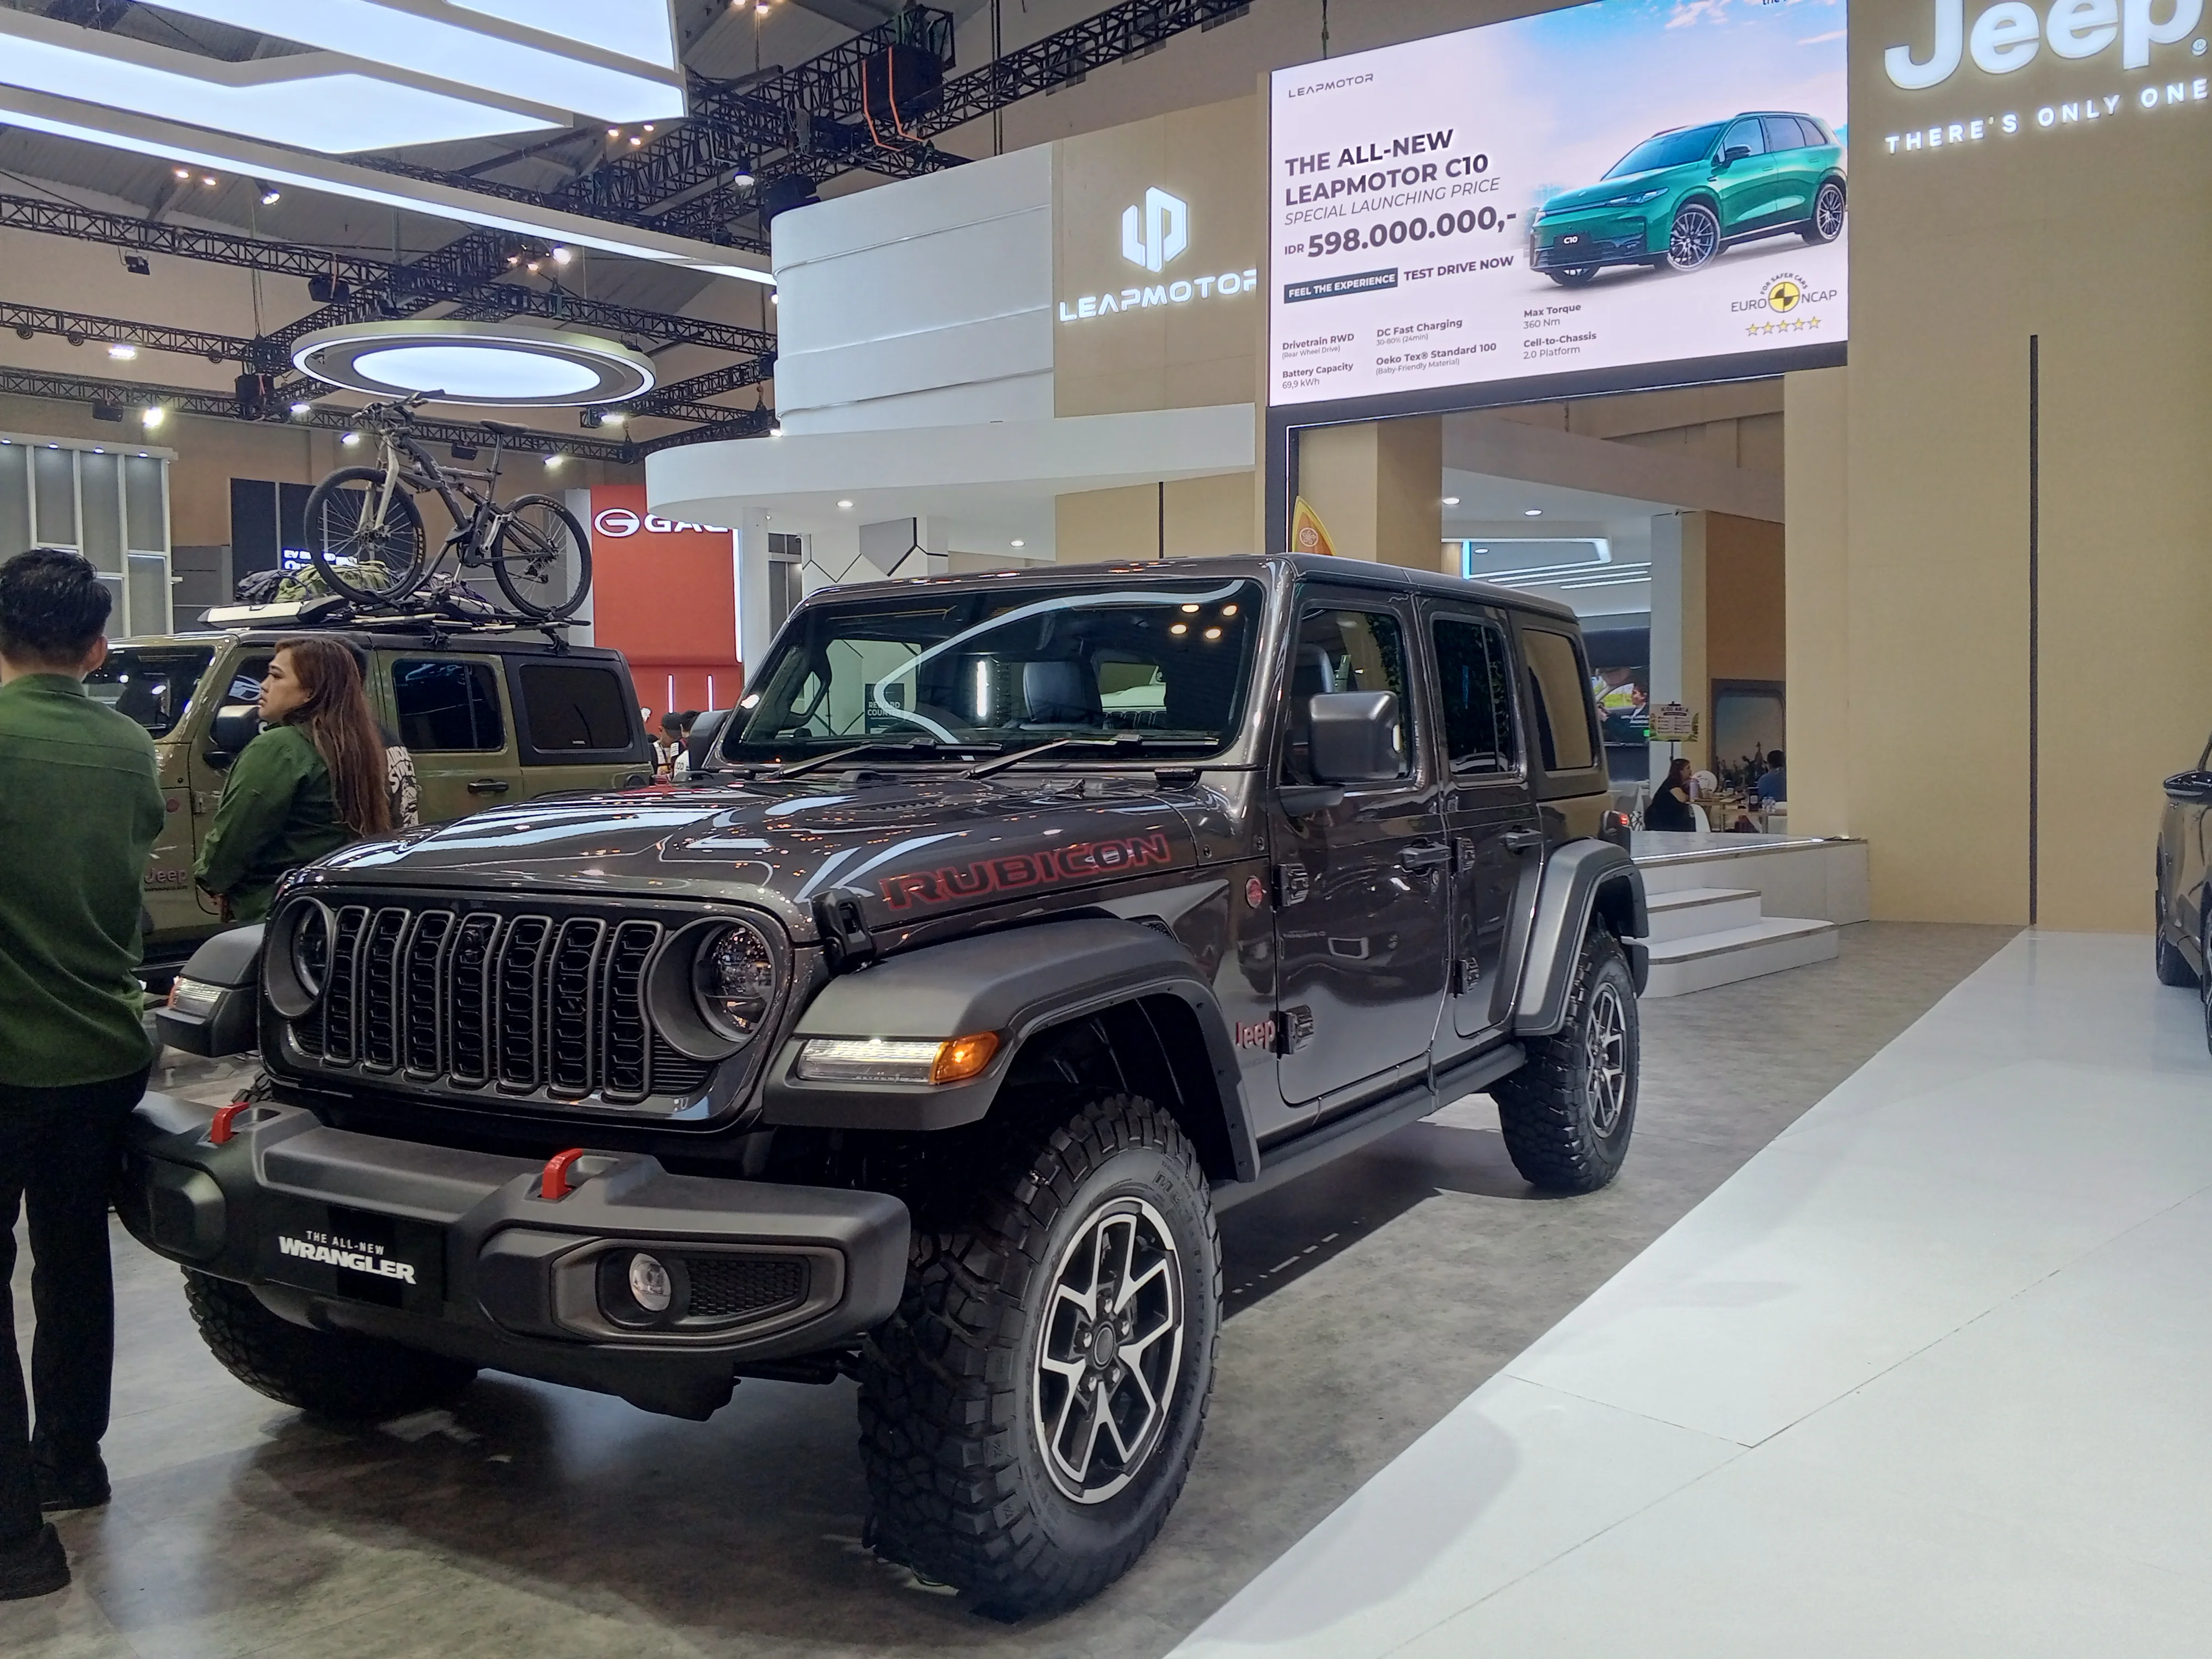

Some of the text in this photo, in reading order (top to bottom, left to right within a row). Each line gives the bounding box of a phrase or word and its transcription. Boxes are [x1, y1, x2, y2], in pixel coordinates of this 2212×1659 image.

[1884, 0, 2203, 89] Jeep
[1288, 73, 1374, 98] LEAPMOTOR
[1885, 78, 2209, 155] THERE'S ONLY ONE
[1285, 129, 1454, 176] THE ALL-NEW
[1286, 154, 1489, 206] LEAPMOTOR C10
[1284, 177, 1501, 225] SPECIAL LAUNCHING PRICE
[1284, 206, 1517, 258] IDR 598.000.000,-
[1563, 236, 1578, 244] C10
[1288, 255, 1515, 299] FEEL THE EXPERIENCE TEST DRIVE NOW
[1760, 273, 1809, 295] FOR SAFER CARS
[1523, 303, 1582, 318] Max Torque
[1731, 290, 1838, 312] EURO NCAP
[1377, 318, 1463, 337] DC Fast Charging
[1523, 316, 1560, 329] 360 Nm
[1282, 333, 1355, 351] Drivetrain RWD
[1376, 333, 1428, 346] 30-80% (24min)
[1523, 331, 1597, 348] Cell-to-Chassis
[1282, 345, 1341, 360] (Rear Wheel Drive)
[1376, 354, 1402, 365] Oeko
[1430, 344, 1477, 359] Standard
[1479, 342, 1497, 352] 100
[1523, 345, 1581, 360] 2.0 Platform
[1282, 362, 1354, 379] Battery Capacity
[1376, 358, 1460, 376] (Baby-Friendly Material)
[1282, 377, 1320, 390] 69,9 kWh
[144, 868, 187, 884] Jeep
[880, 833, 1171, 910] RUBICON
[1235, 1020, 1276, 1049] Jeep
[305, 1230, 384, 1256] THE ALL-NEW
[278, 1236, 417, 1285] WRANGLER
